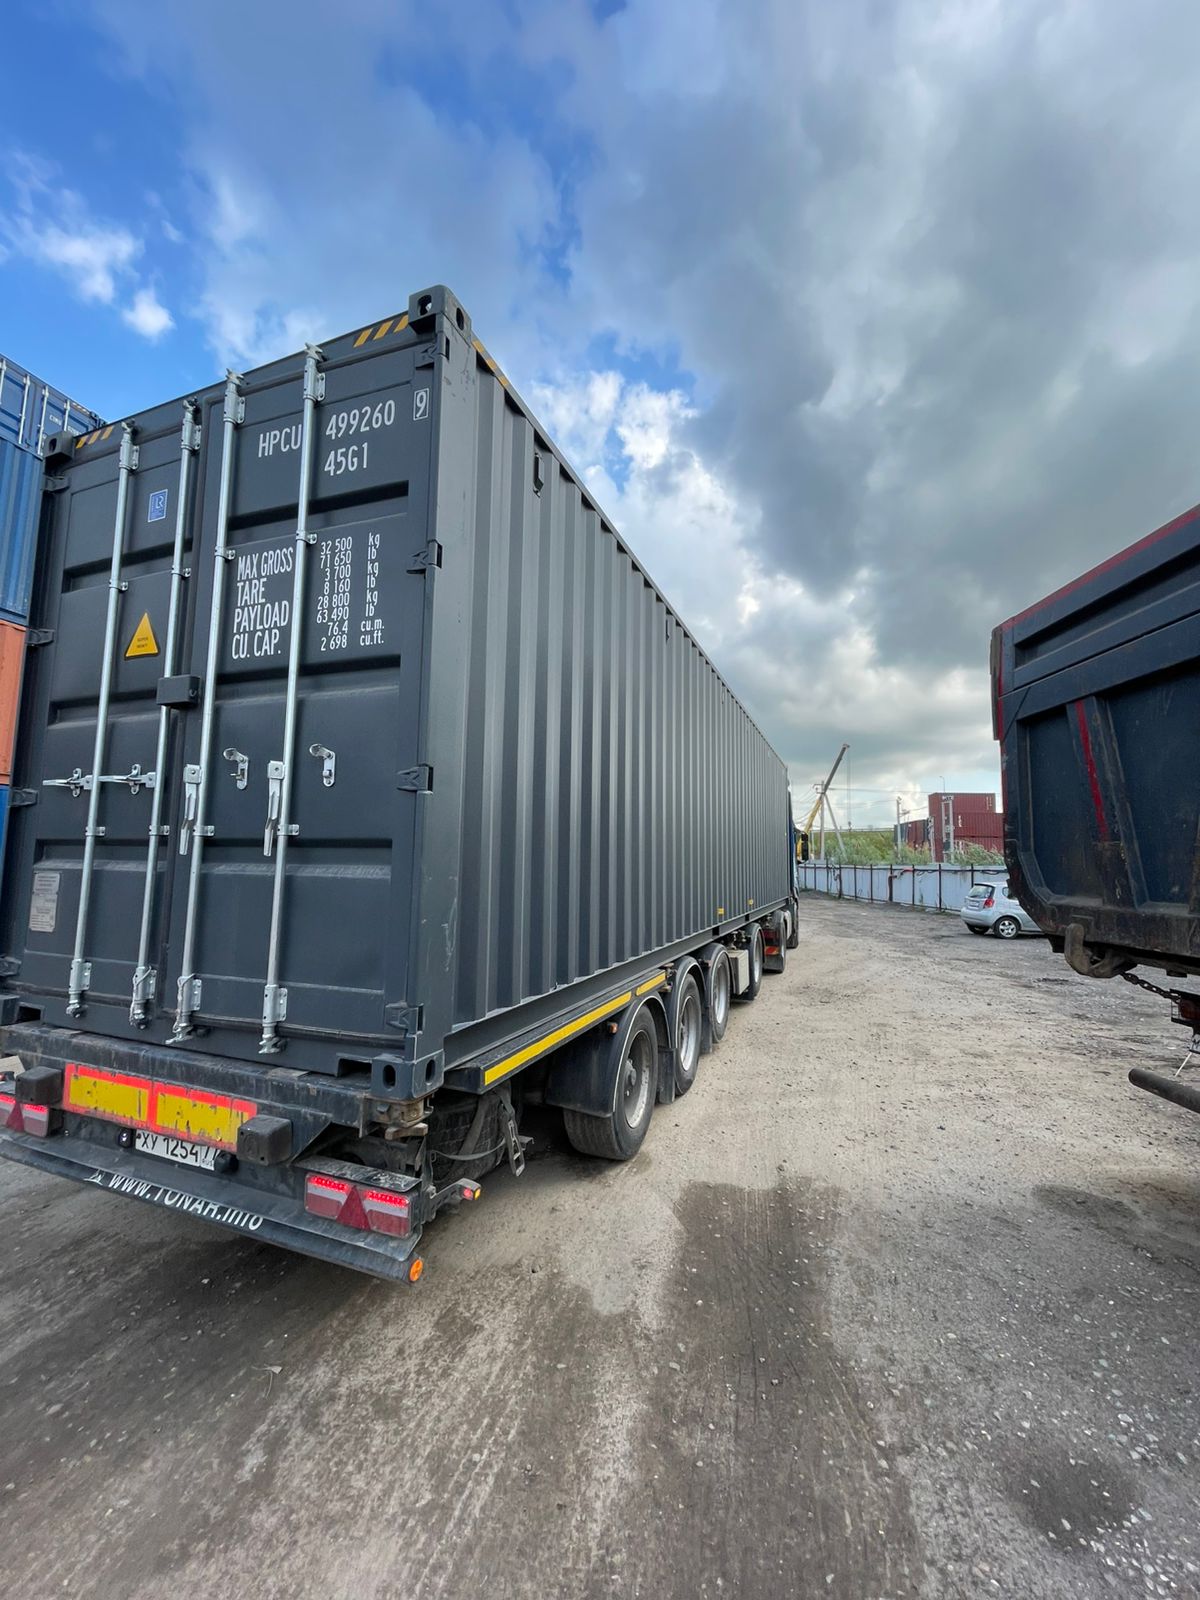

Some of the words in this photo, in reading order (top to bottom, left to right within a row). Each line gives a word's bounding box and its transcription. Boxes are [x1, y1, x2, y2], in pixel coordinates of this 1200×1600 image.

[258, 424, 302, 457] HPCU
[326, 400, 395, 439] 499260
[416, 392, 426, 417] 9
[324, 442, 368, 476] 45G1
[237, 553, 258, 580] MAX
[261, 546, 293, 576] GROSS
[321, 541, 332, 555] 32
[335, 536, 352, 553] 500
[368, 532, 380, 548] kg
[320, 555, 330, 569] 71
[334, 550, 351, 566] 650
[368, 546, 376, 559] lb
[237, 578, 267, 606] TARE
[325, 568, 330, 581] 3
[334, 565, 350, 580] 700
[368, 561, 378, 577] kg
[324, 582, 329, 595] 8
[334, 578, 350, 593] 160
[367, 575, 375, 588] lb
[234, 600, 289, 633] PAYLOAD
[318, 596, 328, 610] 28
[332, 593, 350, 608] 800
[366, 590, 378, 606] kg
[317, 610, 328, 623] 63
[331, 607, 349, 621] 490
[366, 603, 374, 617] lb
[232, 633, 250, 659] CU.
[254, 629, 281, 656] CAP.
[327, 620, 348, 636] 76.4
[361, 619, 384, 632] cu.m.
[321, 637, 326, 651] 2
[330, 635, 347, 650] 698
[360, 630, 384, 646] cu.ft.
[163, 1137, 198, 1162] 1254
